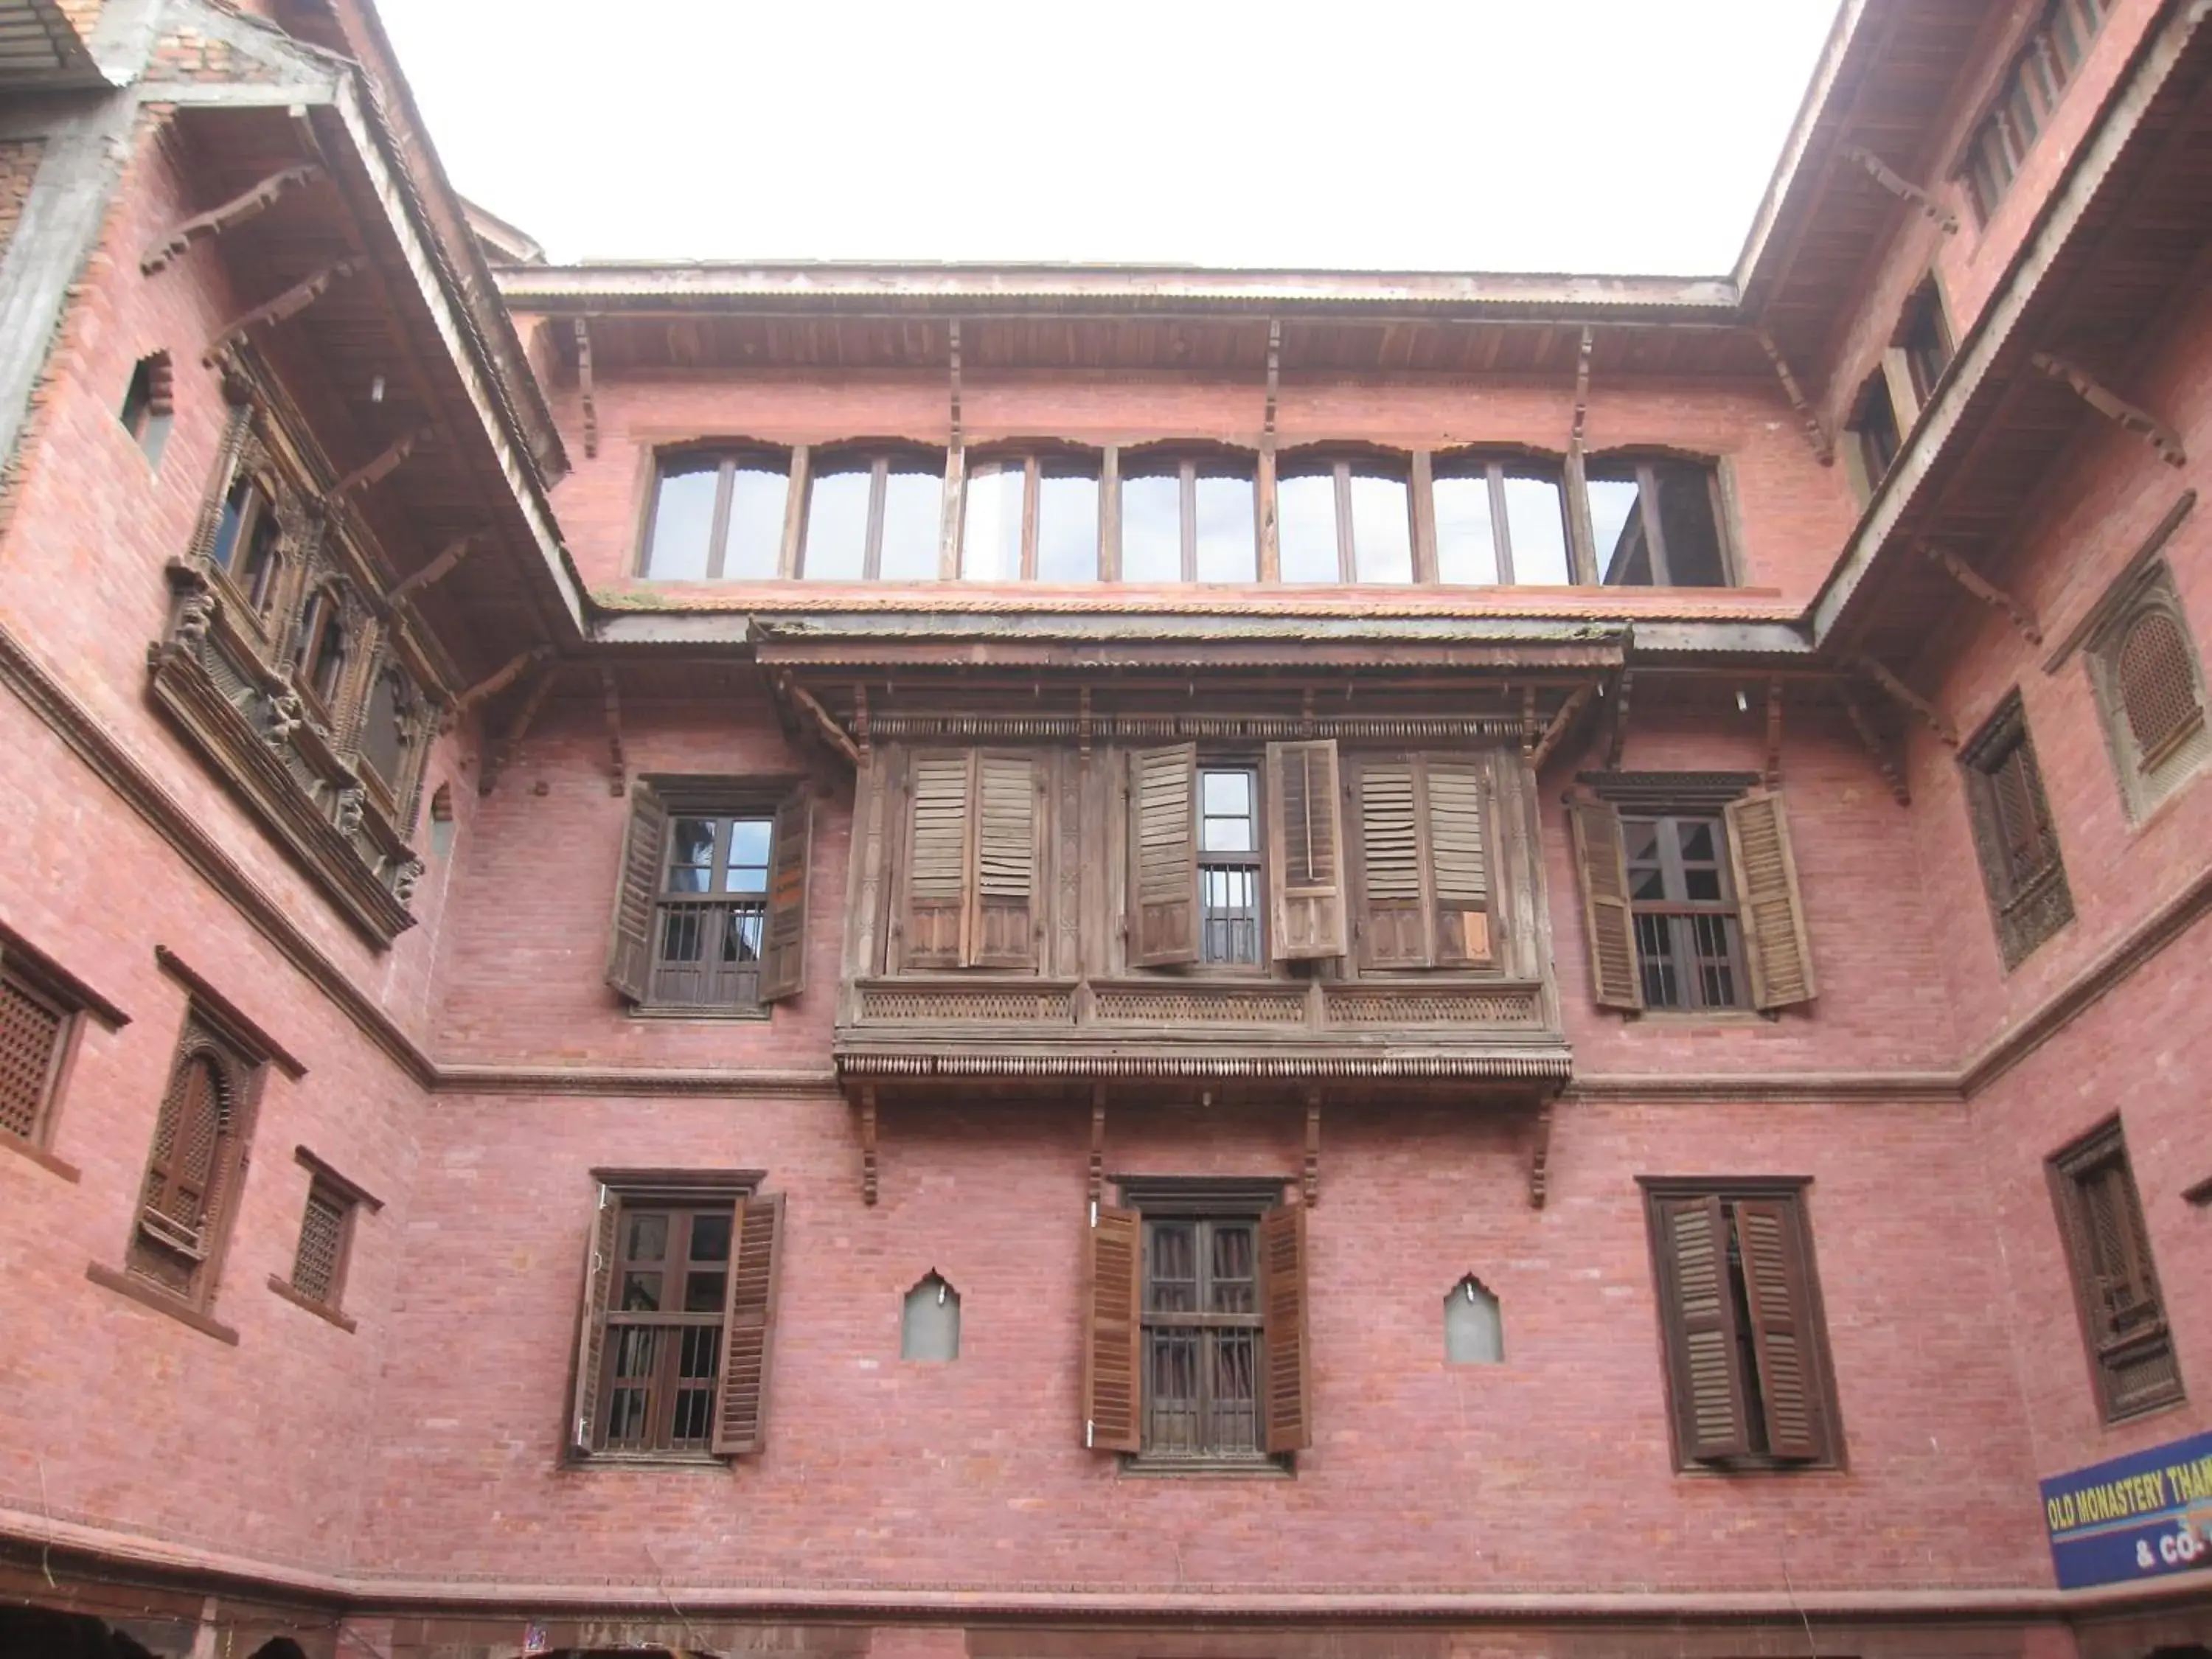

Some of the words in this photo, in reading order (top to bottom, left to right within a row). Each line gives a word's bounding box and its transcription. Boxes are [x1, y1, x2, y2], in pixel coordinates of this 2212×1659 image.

[2048, 1494, 2075, 1530] OLD
[2076, 1470, 2166, 1523] MONASTERY
[2136, 1540, 2154, 1569] &
